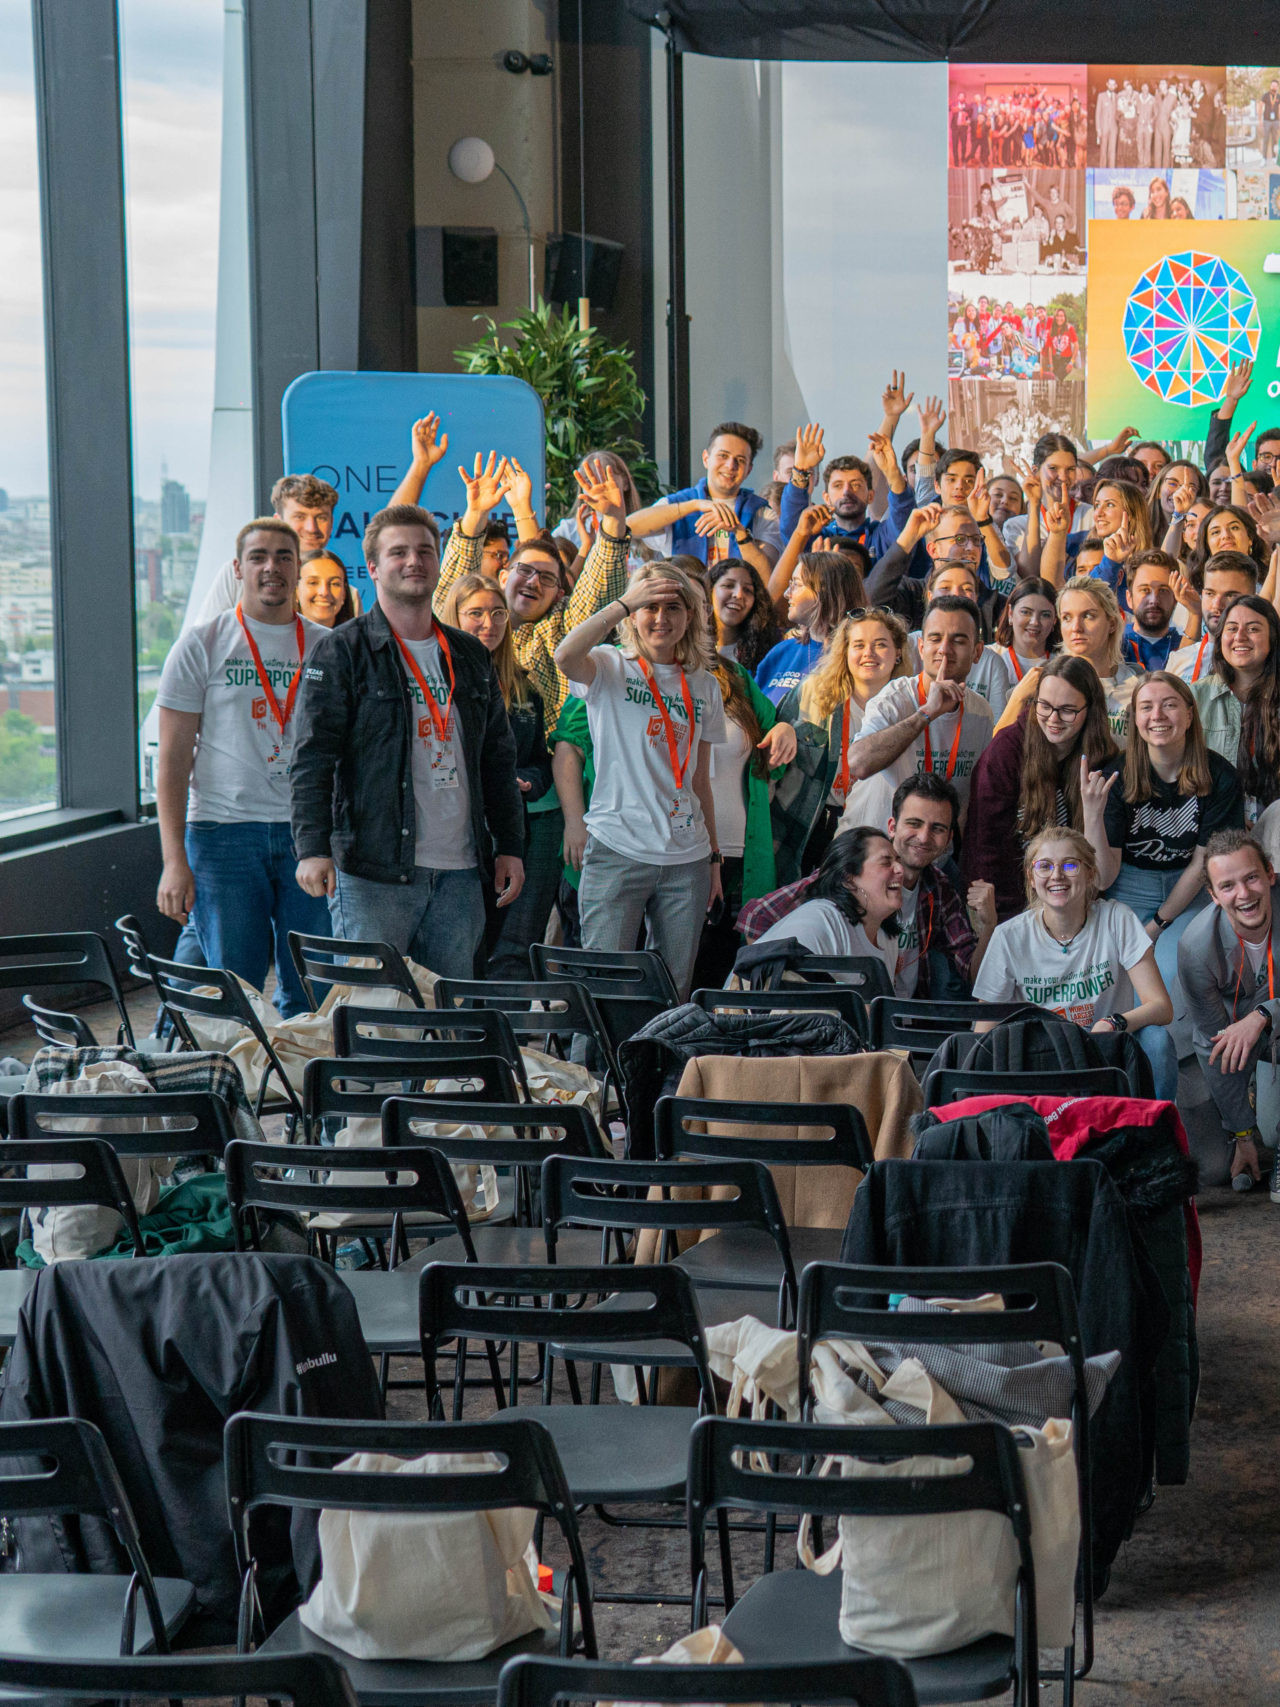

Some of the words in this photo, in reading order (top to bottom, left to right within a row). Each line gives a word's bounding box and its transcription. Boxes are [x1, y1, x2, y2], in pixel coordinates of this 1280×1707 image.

[311, 464, 397, 493] ONE
[1023, 975, 1042, 985] make
[1025, 970, 1115, 1004] SUPERPOWER
